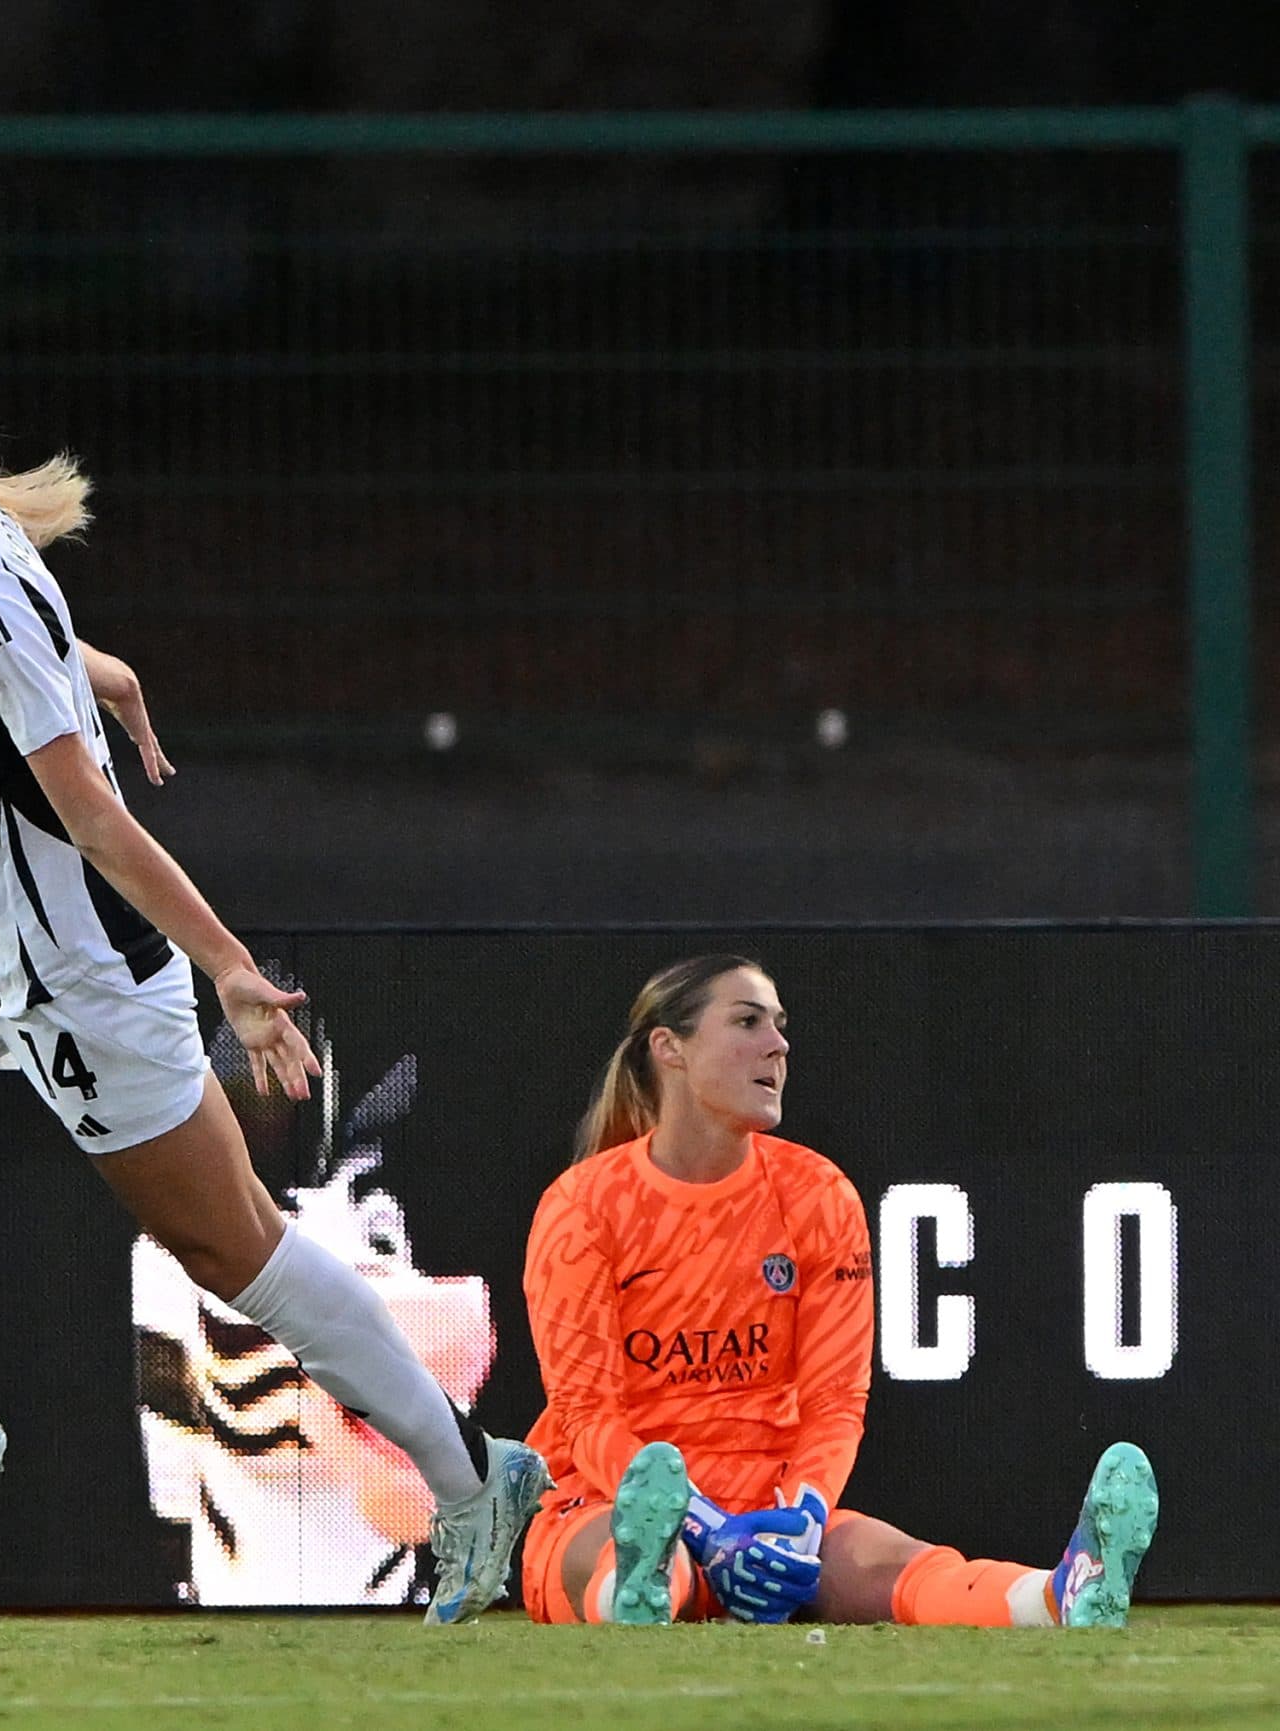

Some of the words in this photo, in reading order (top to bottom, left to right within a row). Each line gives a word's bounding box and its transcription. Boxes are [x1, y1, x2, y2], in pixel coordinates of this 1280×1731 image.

[17, 1028, 98, 1101] 14
[879, 1182, 1179, 1381] CO
[624, 1323, 769, 1372] QATAR
[664, 1359, 769, 1385] AIRWAYS
